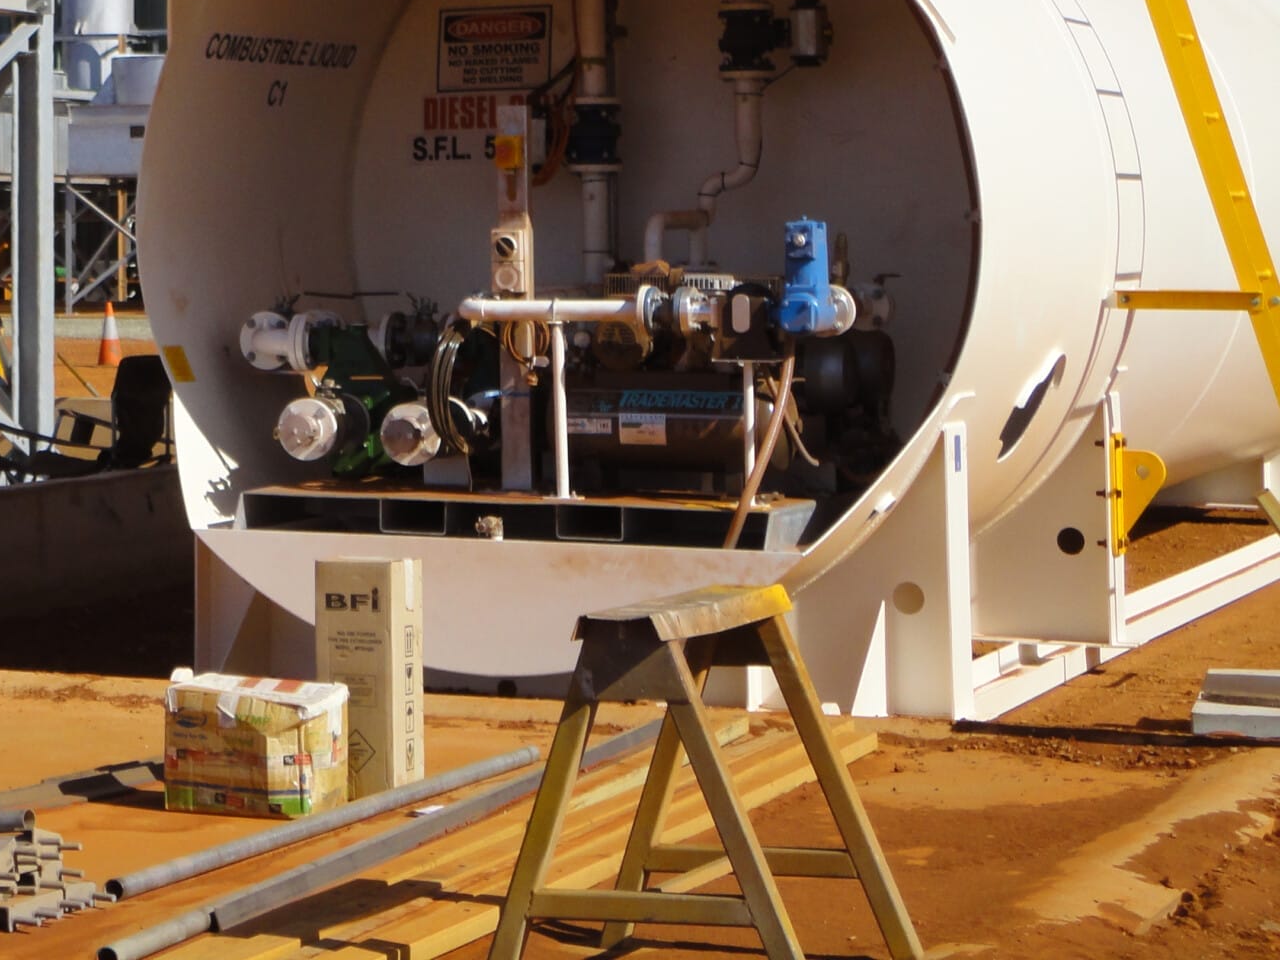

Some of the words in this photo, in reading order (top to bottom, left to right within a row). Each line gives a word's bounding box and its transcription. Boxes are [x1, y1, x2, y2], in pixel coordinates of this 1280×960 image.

[455, 20, 532, 36] DANGER
[205, 33, 312, 67] COMBUSTIBLE
[310, 42, 358, 69] LIQUID
[448, 45, 467, 56] NO
[472, 42, 540, 56] SMOKING
[267, 80, 288, 107] C1
[423, 95, 497, 130] DIESEL
[413, 136, 472, 161] S.F.L.
